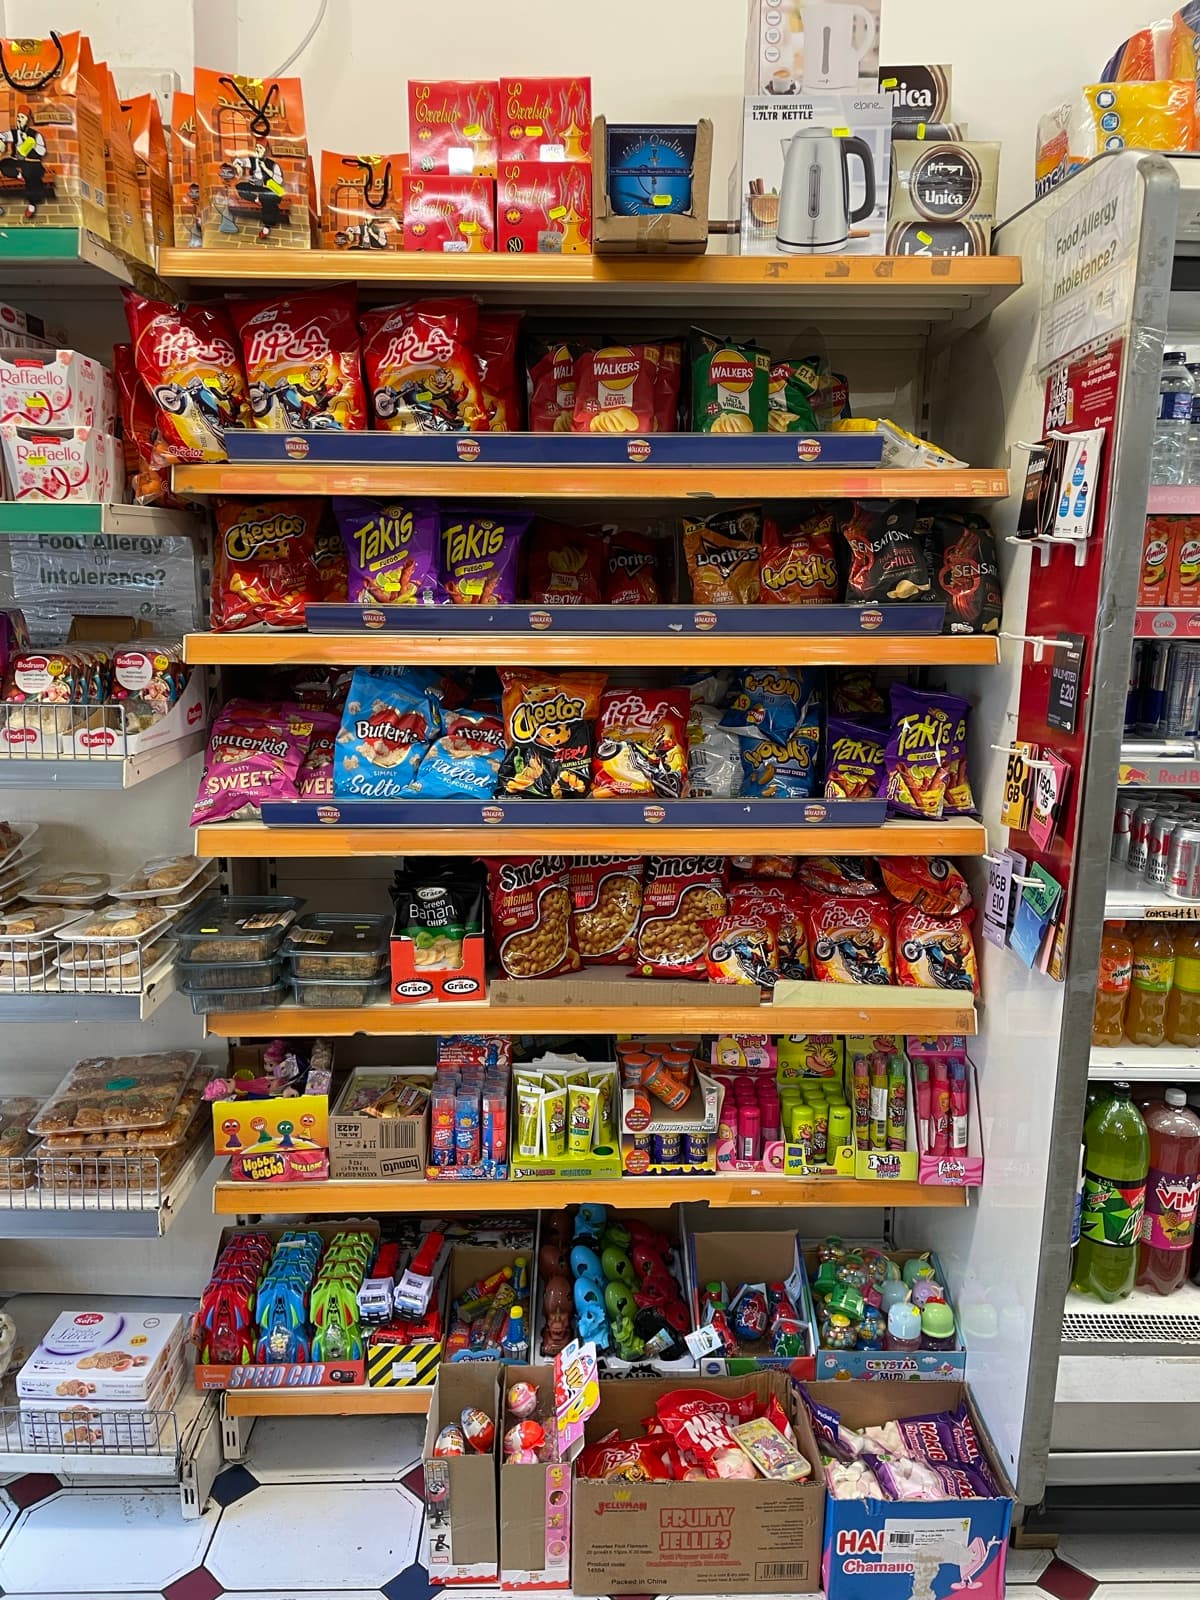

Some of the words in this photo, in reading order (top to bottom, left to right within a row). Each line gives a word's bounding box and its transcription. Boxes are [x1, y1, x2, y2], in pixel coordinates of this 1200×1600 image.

[752, 111, 778, 120] 1.7LTR
[782, 111, 813, 120] KETTLE
[622, 135, 646, 159] High
[649, 133, 686, 158] Quality
[925, 190, 963, 205] Unica
[1055, 223, 1079, 260] Food
[1080, 196, 1118, 246] Allergy
[508, 238, 522, 252] 80
[1052, 239, 1117, 301] Intolerance?
[593, 360, 641, 376] WALKERS
[711, 366, 753, 379] WALKERS
[0, 369, 63, 386] Raffaello
[722, 401, 746, 411] VINEGAR
[16, 445, 81, 462] Raffaello
[285, 441, 309, 453] WALKERS
[456, 444, 481, 453] WALKERS
[627, 444, 651, 453] WALKERS
[797, 443, 822, 453] WALKERS
[39, 534, 87, 550] Food
[92, 534, 163, 554] Allergy
[226, 516, 305, 559] Cheetos
[353, 511, 414, 568] Takis
[850, 530, 912, 553] SENSATION
[442, 522, 505, 571] Takis
[379, 555, 399, 567] FUEGO
[609, 553, 657, 573] Doritos
[696, 547, 759, 566] Doritos
[39, 567, 167, 586] Intolerance?
[463, 564, 482, 574] FUEGO
[762, 555, 837, 588] Wotsits
[362, 615, 386, 624] WALKERS
[529, 616, 553, 624] WALKERS
[694, 615, 718, 624] WALKERS
[860, 615, 884, 623] WALKERS
[17, 661, 45, 669] Bodrum
[116, 657, 143, 666] Bodrum
[1053, 669, 1077, 682] UNLIMITED
[1060, 683, 1075, 701] £20
[510, 697, 586, 742] Cheetos
[83, 735, 113, 746] Bodrum
[897, 713, 952, 757] Takis
[211, 734, 289, 757] Butterkist
[831, 739, 886, 766] Takis
[917, 752, 936, 760] FUEGO
[1007, 754, 1023, 784] 50
[1158, 770, 1188, 783] Red
[207, 770, 273, 794] SWEET
[1007, 783, 1020, 803] GB
[317, 811, 341, 819] WALKERS
[482, 810, 505, 818] WALKERS
[643, 809, 666, 818] WALKERS
[804, 809, 827, 818] WALKERS
[423, 899, 445, 909] Green
[502, 891, 533, 907] ORIGINAL
[992, 893, 1005, 911] £10
[426, 917, 448, 927] CHIPS
[400, 985, 429, 993] Grace
[447, 982, 475, 991] Grace
[242, 1155, 276, 1172] Hubba
[251, 1161, 285, 1180] Bubba
[383, 1158, 419, 1173] hanuta
[228, 1365, 285, 1386] SPEED
[286, 1364, 326, 1385] CAR
[659, 1507, 736, 1528] FRUITY
[659, 1530, 733, 1551] JELLIES
